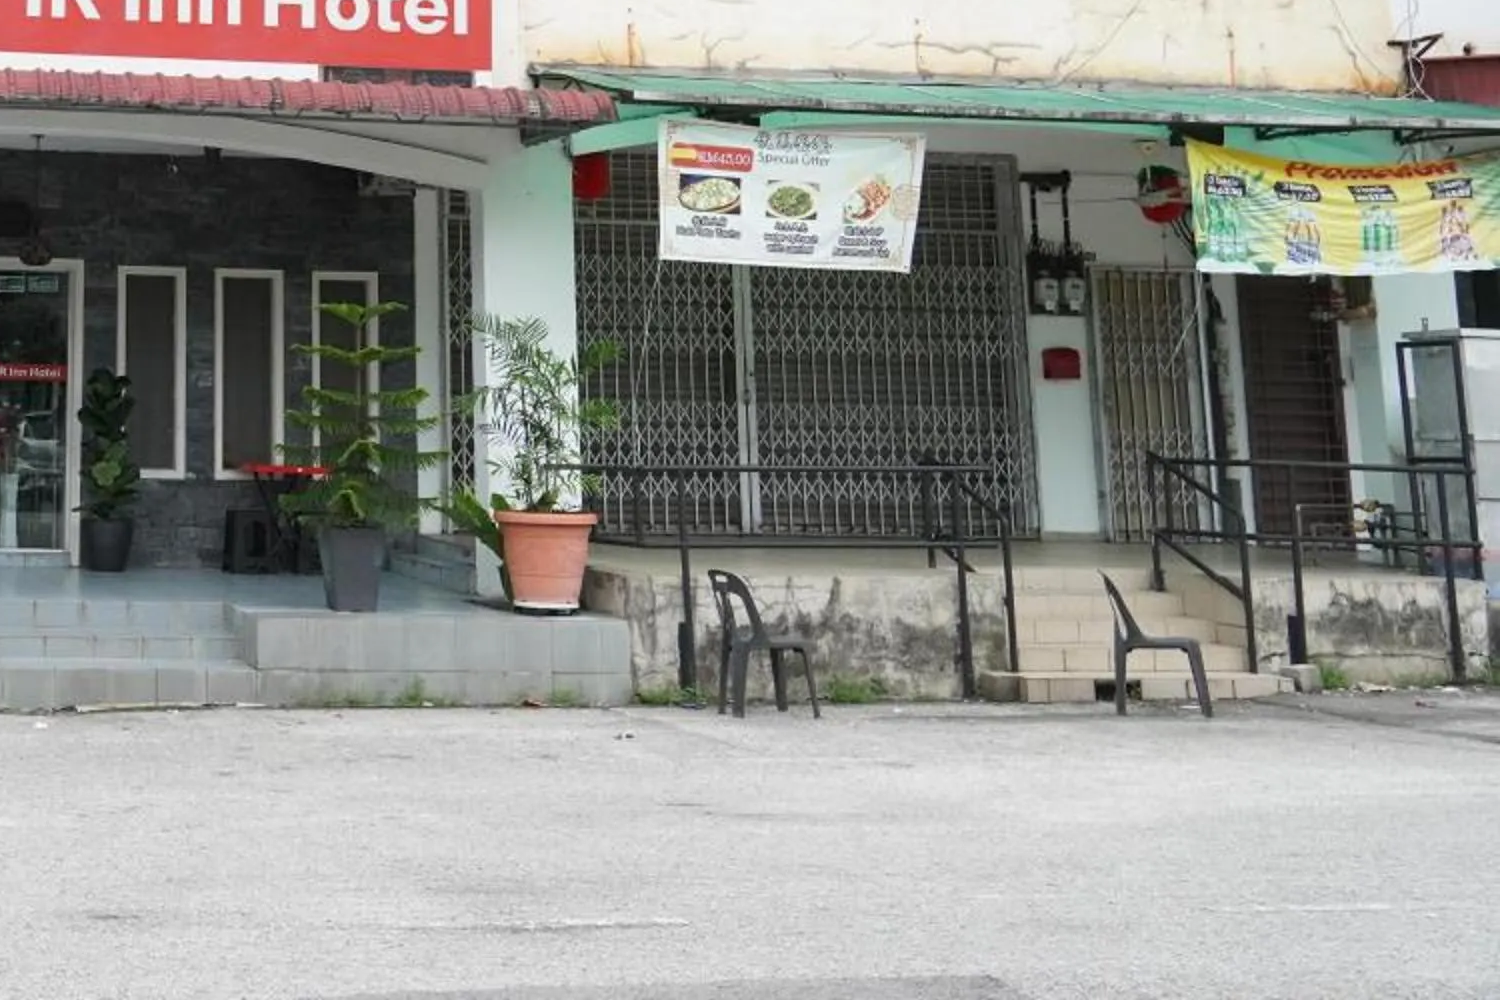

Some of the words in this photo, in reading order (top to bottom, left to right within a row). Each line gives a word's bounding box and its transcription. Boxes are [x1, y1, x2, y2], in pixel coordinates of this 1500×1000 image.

[801, 154, 831, 167] Offer
[9, 367, 27, 377] Inn
[29, 367, 61, 378] Hotel
